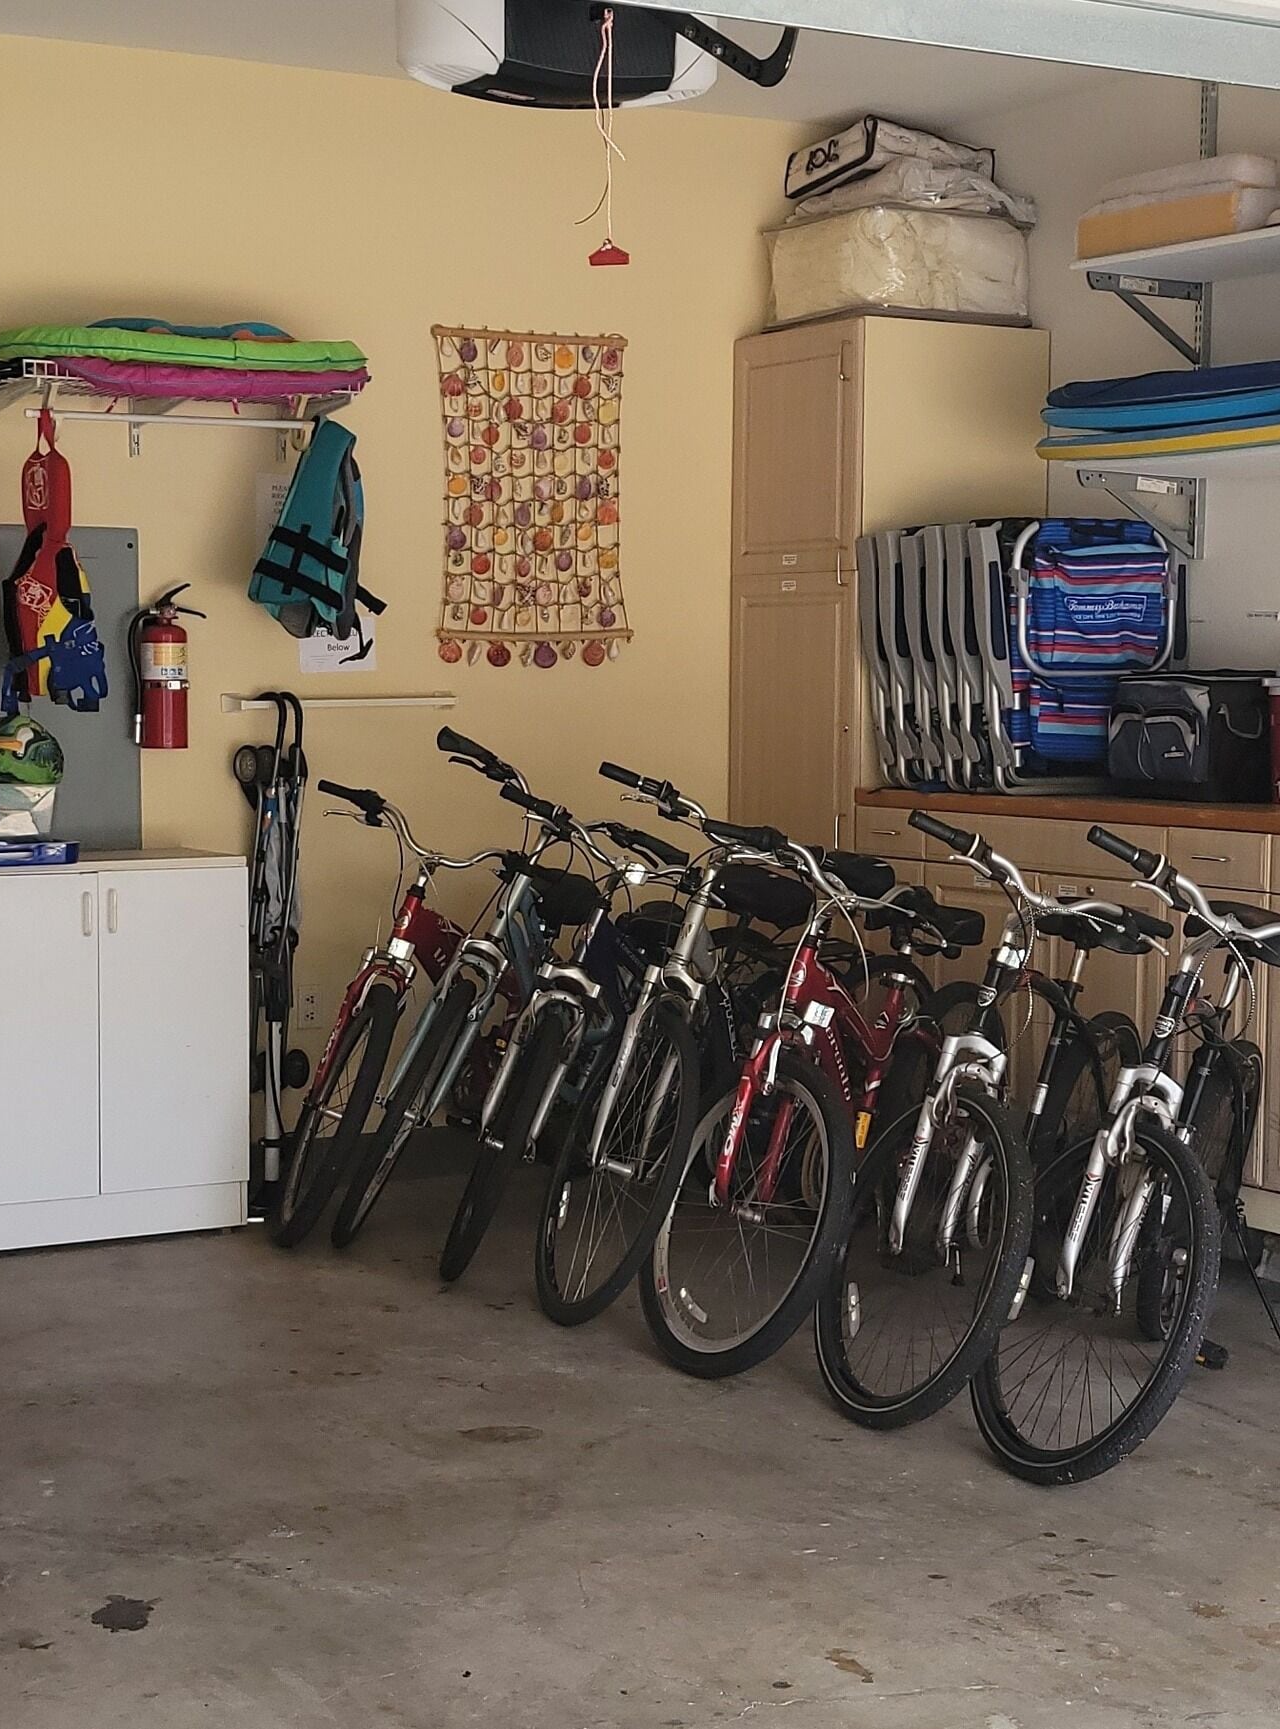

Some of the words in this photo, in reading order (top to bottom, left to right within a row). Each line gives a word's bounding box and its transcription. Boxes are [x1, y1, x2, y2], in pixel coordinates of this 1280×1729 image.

[1068, 599, 1104, 615] Tommy
[1104, 598, 1144, 610] Bahama
[327, 643, 351, 652] Below
